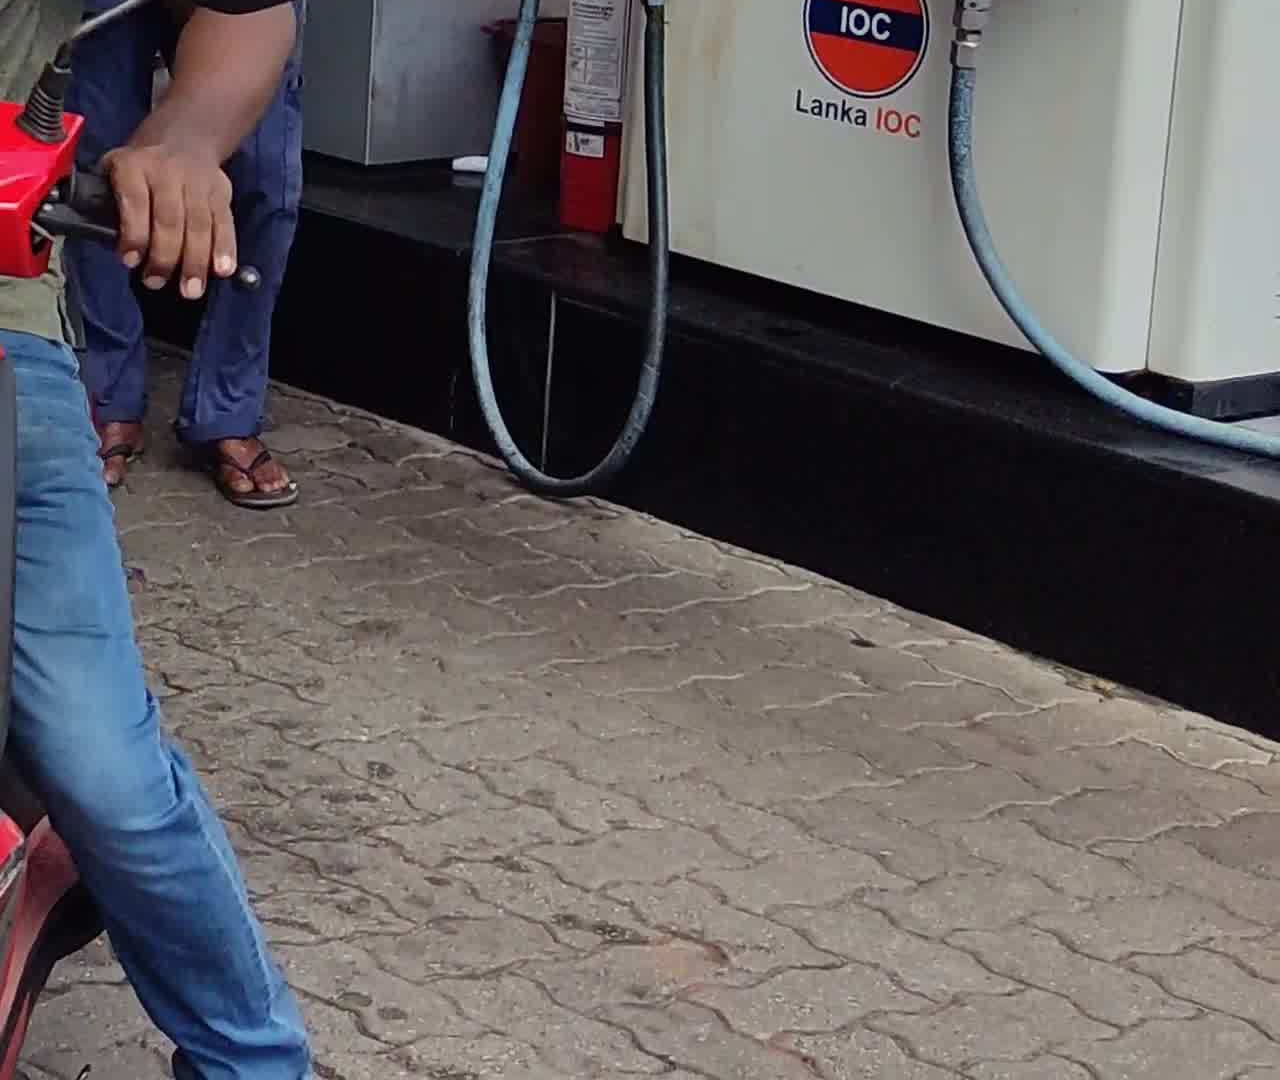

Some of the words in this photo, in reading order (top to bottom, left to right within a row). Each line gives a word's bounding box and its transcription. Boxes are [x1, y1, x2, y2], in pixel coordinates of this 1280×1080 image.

[840, 5, 891, 41] IOC
[796, 88, 868, 128] Lanka
[875, 107, 921, 138] IOC
